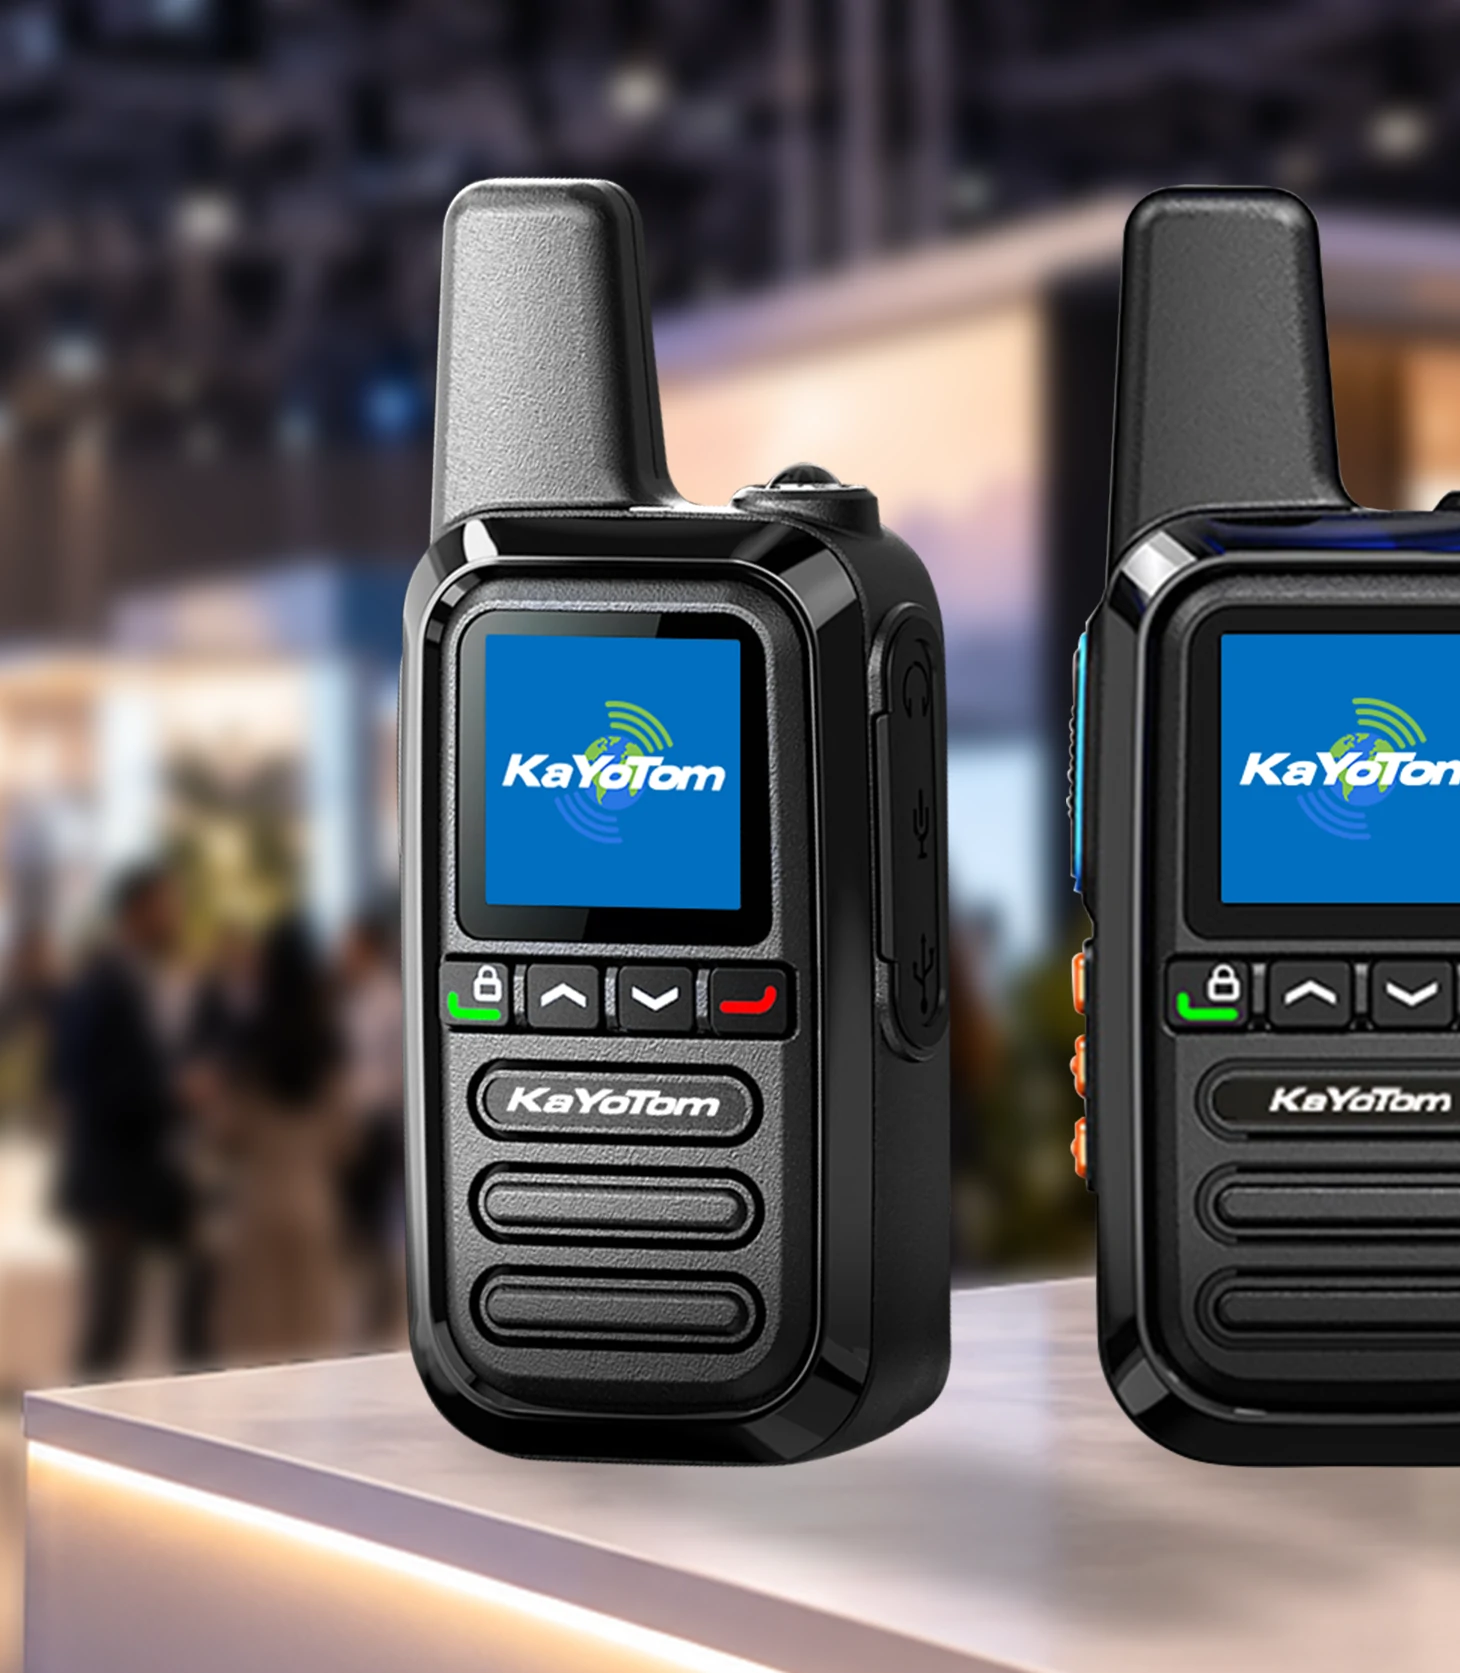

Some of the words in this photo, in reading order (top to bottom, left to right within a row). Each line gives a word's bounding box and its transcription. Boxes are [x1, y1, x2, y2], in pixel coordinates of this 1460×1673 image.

[501, 753, 726, 792] KaYoTom
[505, 1086, 722, 1118] KaYoTom
[1268, 1086, 1453, 1114] KaYoTom
